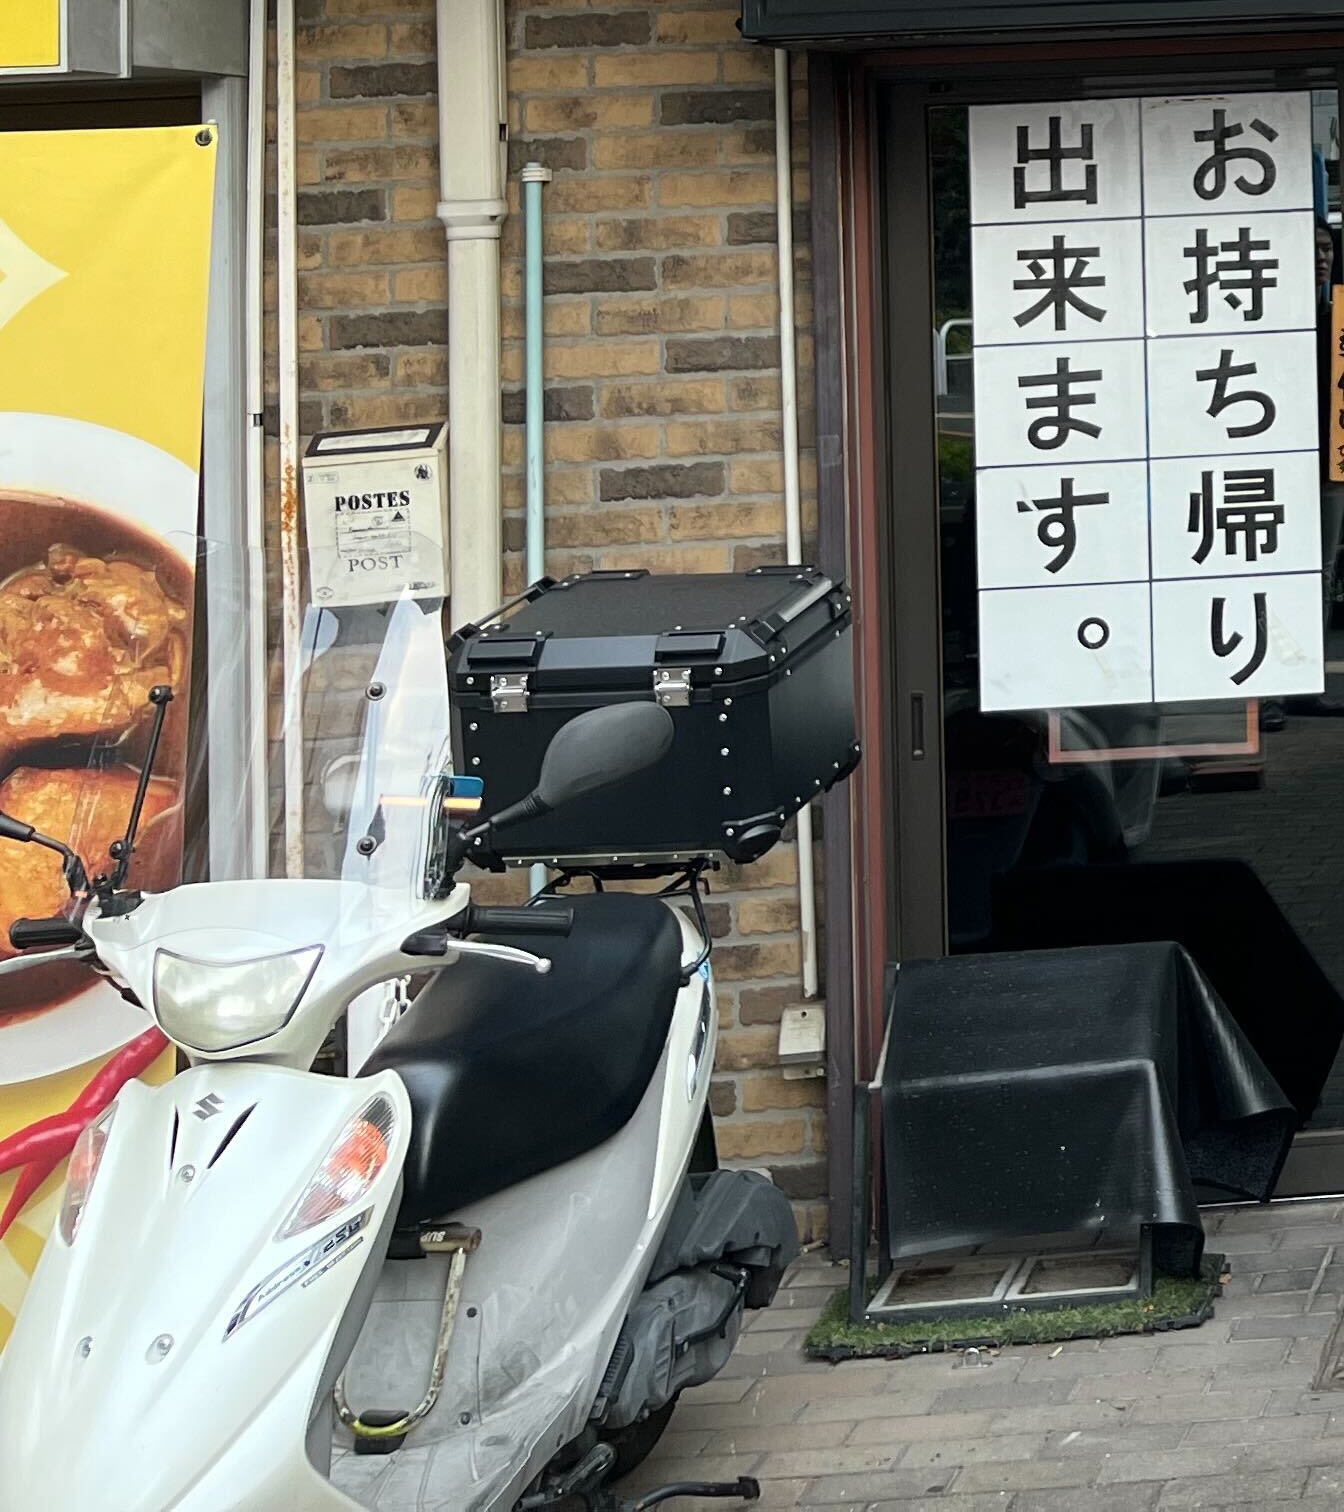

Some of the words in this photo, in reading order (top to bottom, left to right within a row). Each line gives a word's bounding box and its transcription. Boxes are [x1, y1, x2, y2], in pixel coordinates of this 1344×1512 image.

[335, 490, 410, 513] POSTES
[1011, 115, 1111, 651] 出来ます。
[1182, 108, 1287, 686] お持ち帰り
[348, 555, 404, 572] POST
